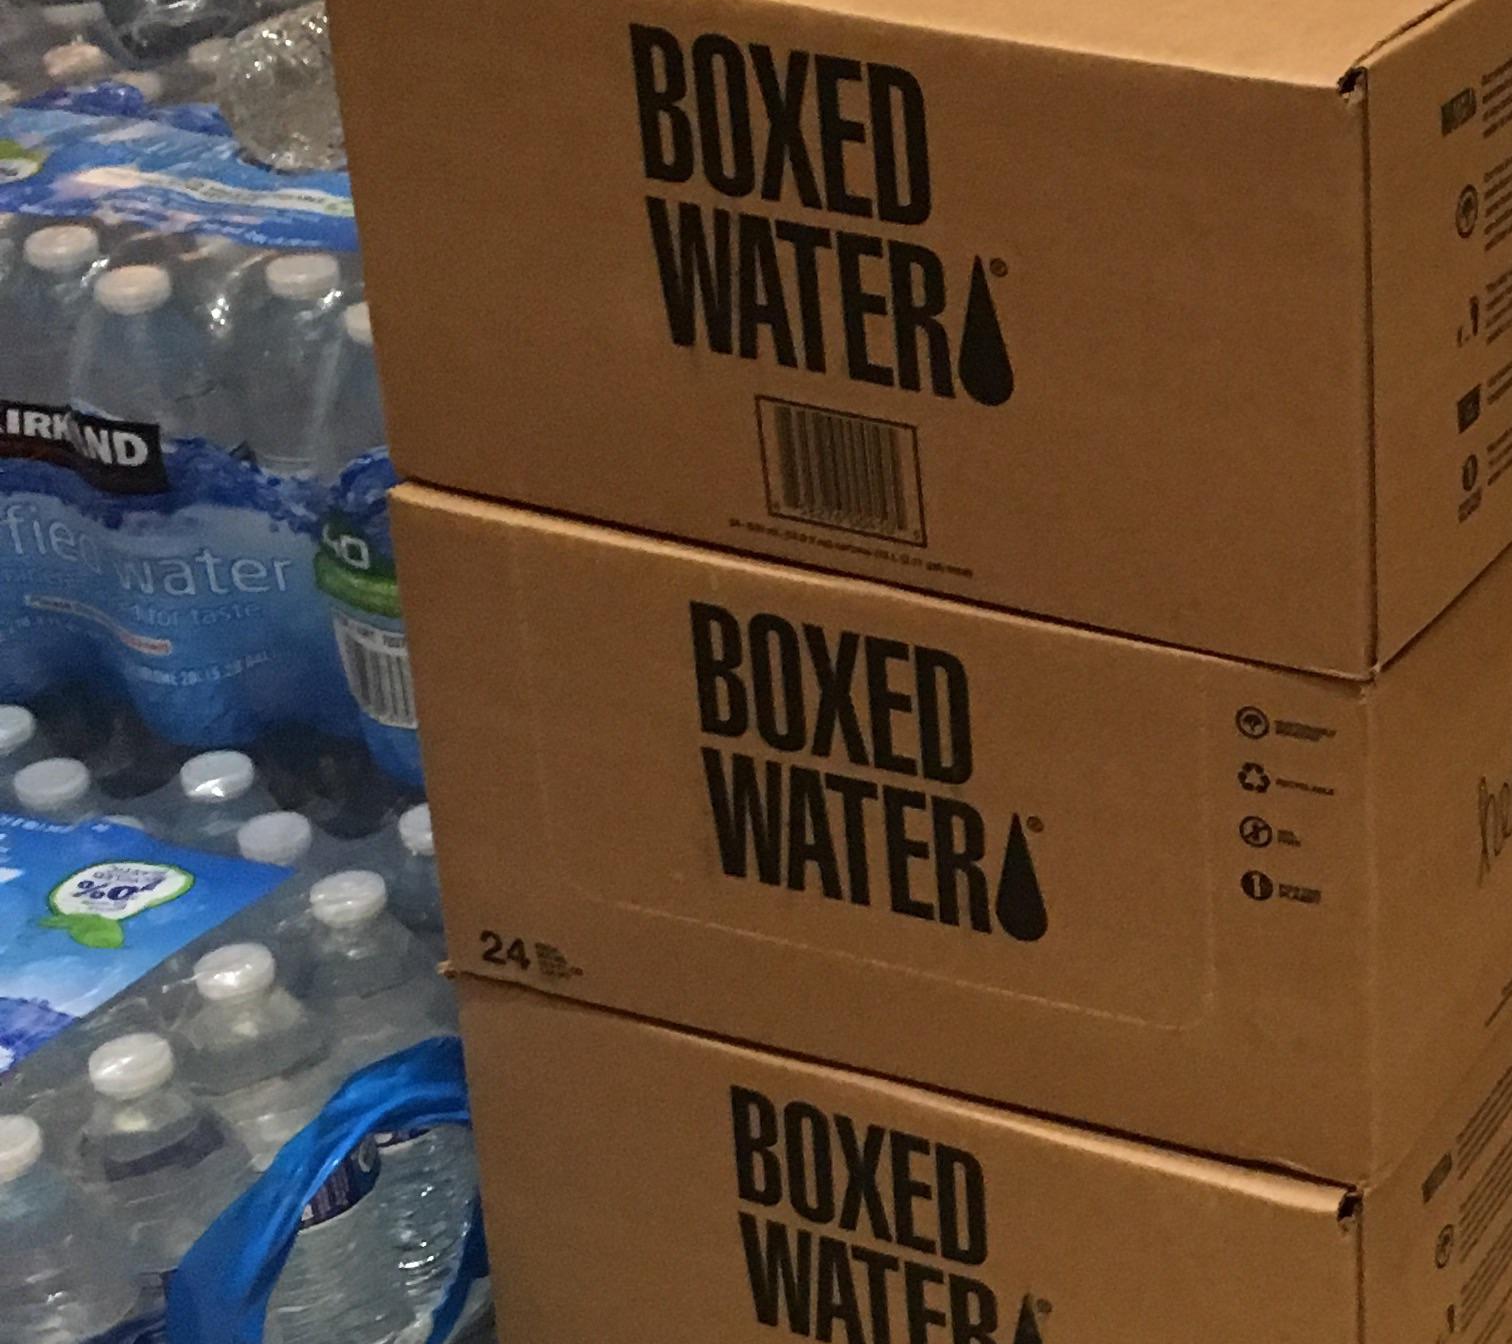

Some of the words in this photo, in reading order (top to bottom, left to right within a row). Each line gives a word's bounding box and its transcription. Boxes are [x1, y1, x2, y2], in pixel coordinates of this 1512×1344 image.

[629, 23, 931, 225] BOXED
[645, 196, 956, 399] WATER
[112, 548, 292, 597] water
[690, 601, 973, 785] BOXED
[701, 747, 992, 934] WATER
[480, 929, 531, 971] 24
[730, 1085, 987, 1266] BOXED
